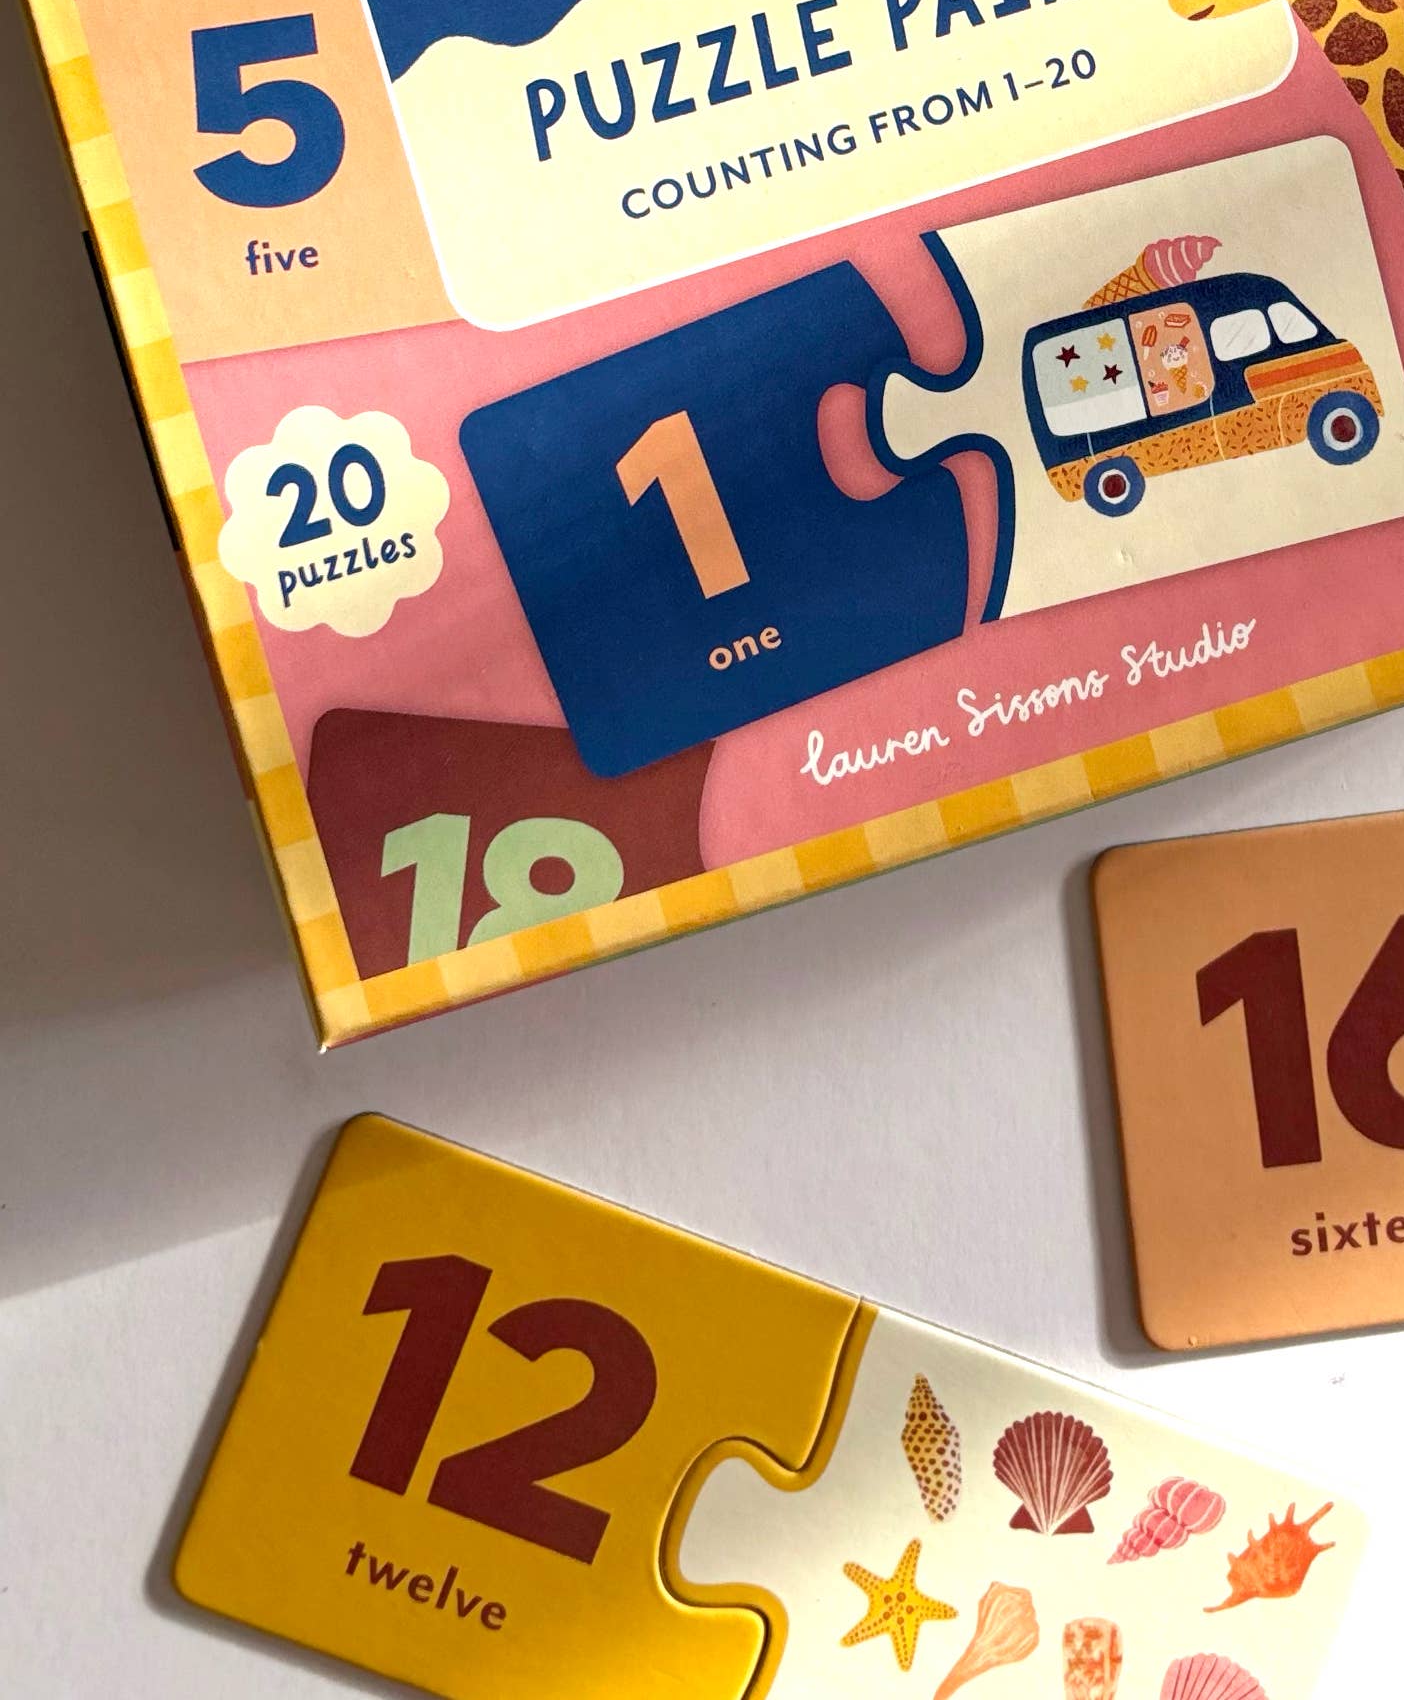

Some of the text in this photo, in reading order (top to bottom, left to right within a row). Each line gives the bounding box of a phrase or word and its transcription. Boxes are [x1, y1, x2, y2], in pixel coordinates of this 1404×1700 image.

[191, 13, 347, 209] 5
[620, 122, 858, 220] COUNTING
[869, 82, 992, 147] FROM
[245, 240, 320, 276] five
[265, 443, 387, 549] 20
[615, 410, 752, 599] 1
[277, 532, 417, 607] puzzles
[708, 621, 783, 672] one
[800, 618, 1258, 786] lauren Sissons Studio
[378, 812, 625, 965] 18
[349, 1254, 658, 1566] 12
[347, 1541, 508, 1632] twelve
